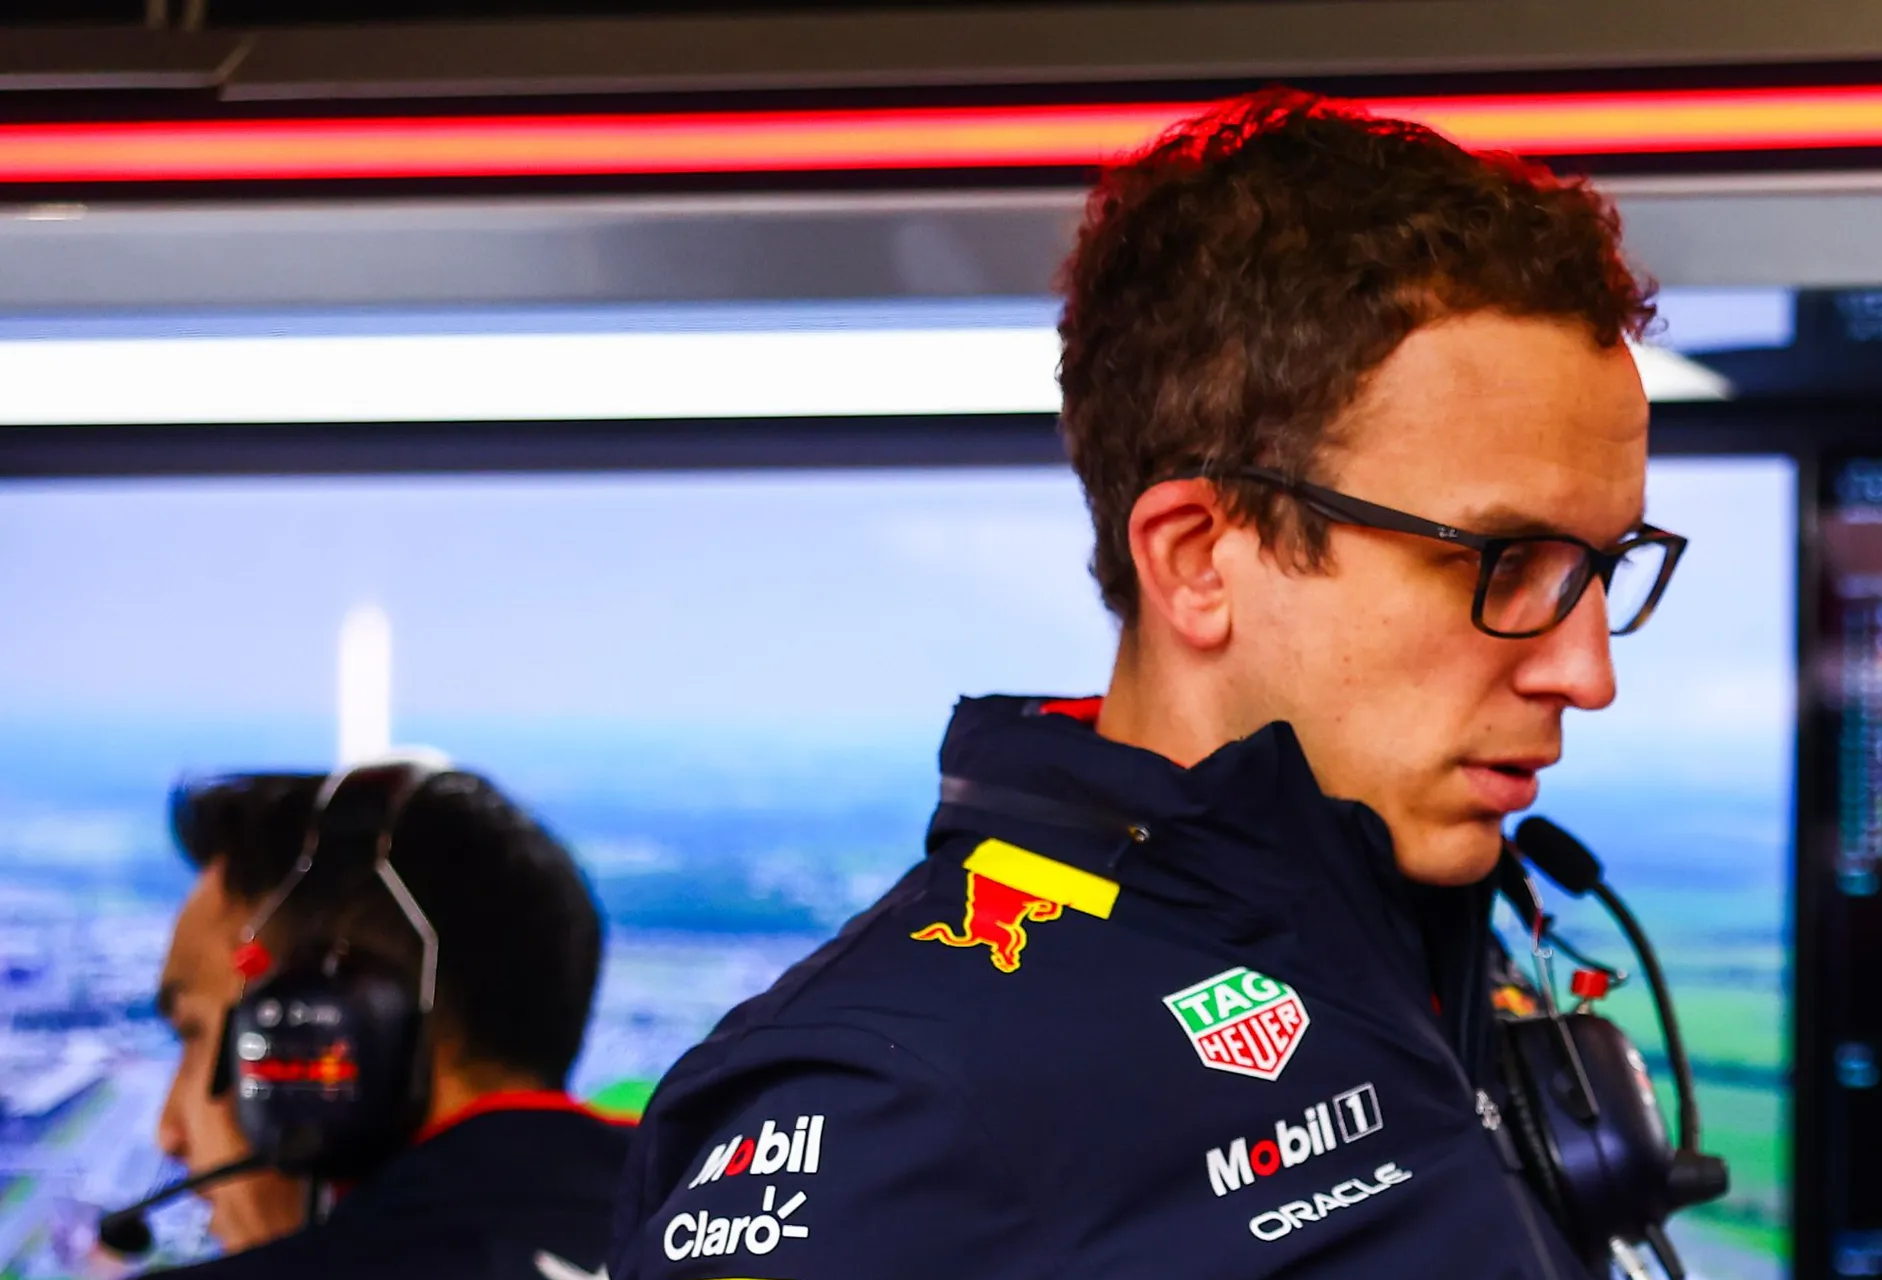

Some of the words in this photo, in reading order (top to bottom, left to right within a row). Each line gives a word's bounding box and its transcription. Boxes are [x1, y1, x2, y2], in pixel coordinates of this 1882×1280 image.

[1178, 971, 1281, 1026] TAG
[1201, 1001, 1301, 1070] HEUER
[688, 1115, 825, 1190] Mobil
[1206, 1102, 1336, 1197] Mobil
[663, 1210, 781, 1261] Claro
[1249, 1161, 1413, 1242] ORACLE
